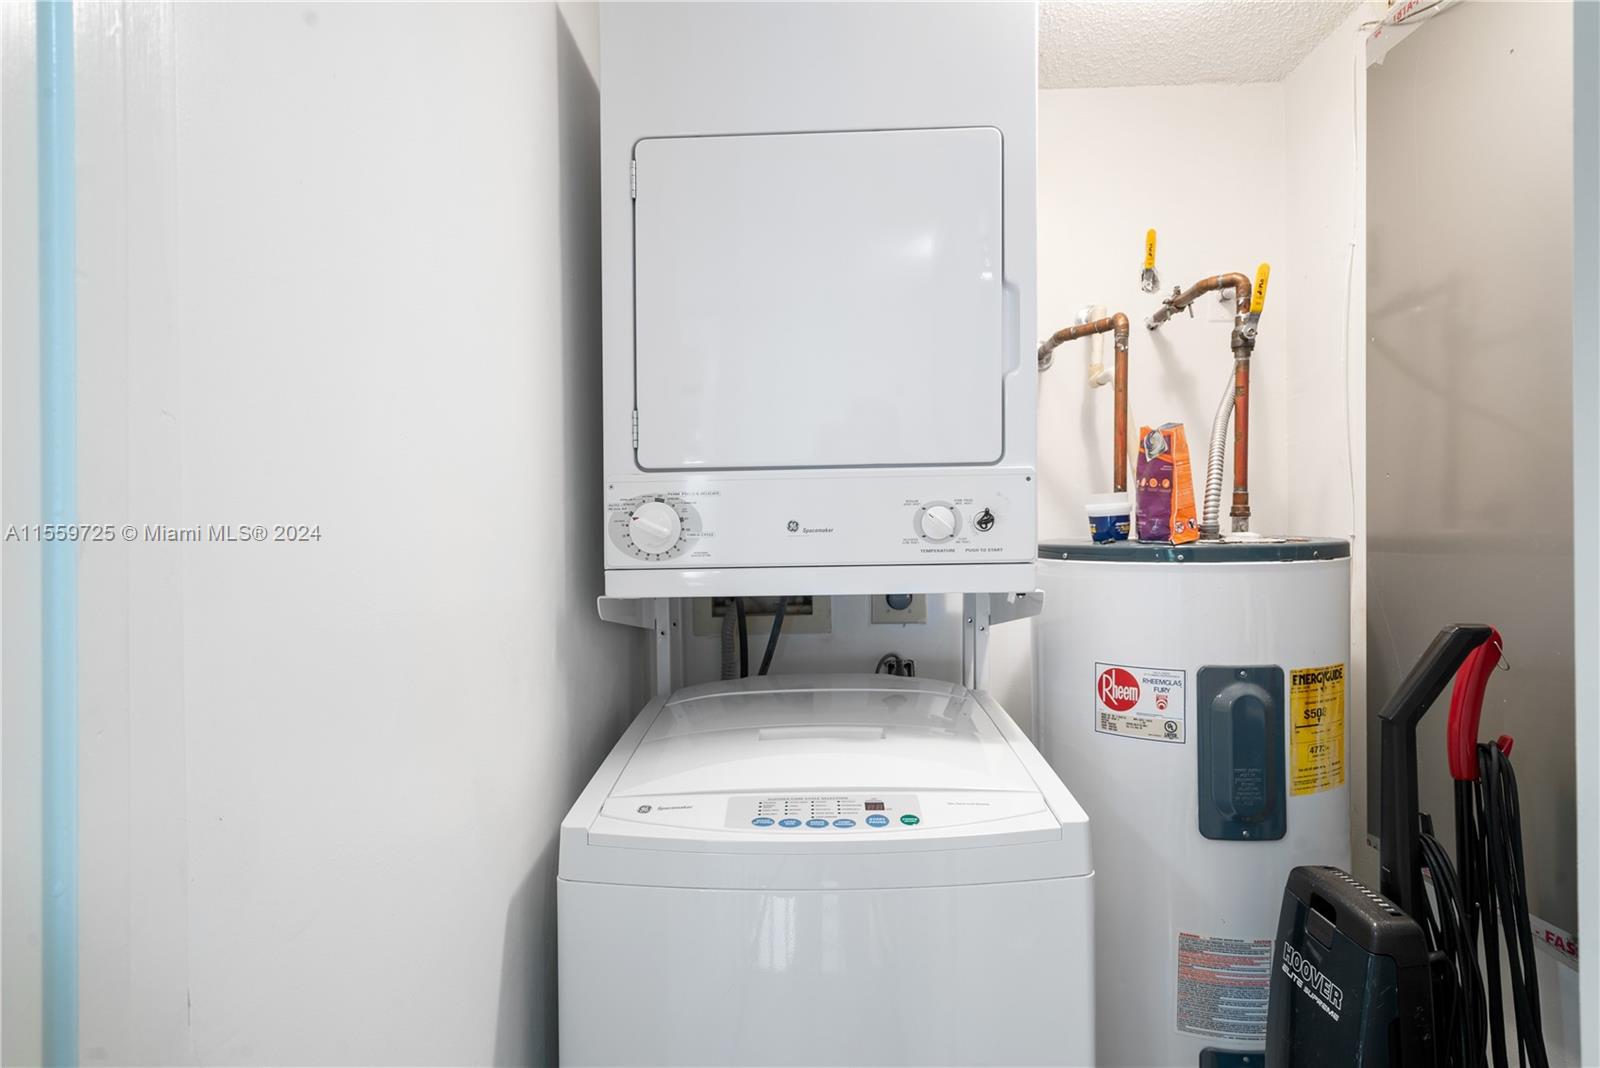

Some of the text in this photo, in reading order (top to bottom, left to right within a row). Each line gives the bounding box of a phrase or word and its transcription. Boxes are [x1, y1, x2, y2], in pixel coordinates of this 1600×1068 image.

[1102, 669, 1138, 705] Rheem
[1142, 677, 1182, 687] RHEEMGLAS
[1153, 686, 1171, 694] FURY
[1281, 963, 1340, 1022] ELITE SUPREME
[1283, 941, 1344, 1011] HOOVER
